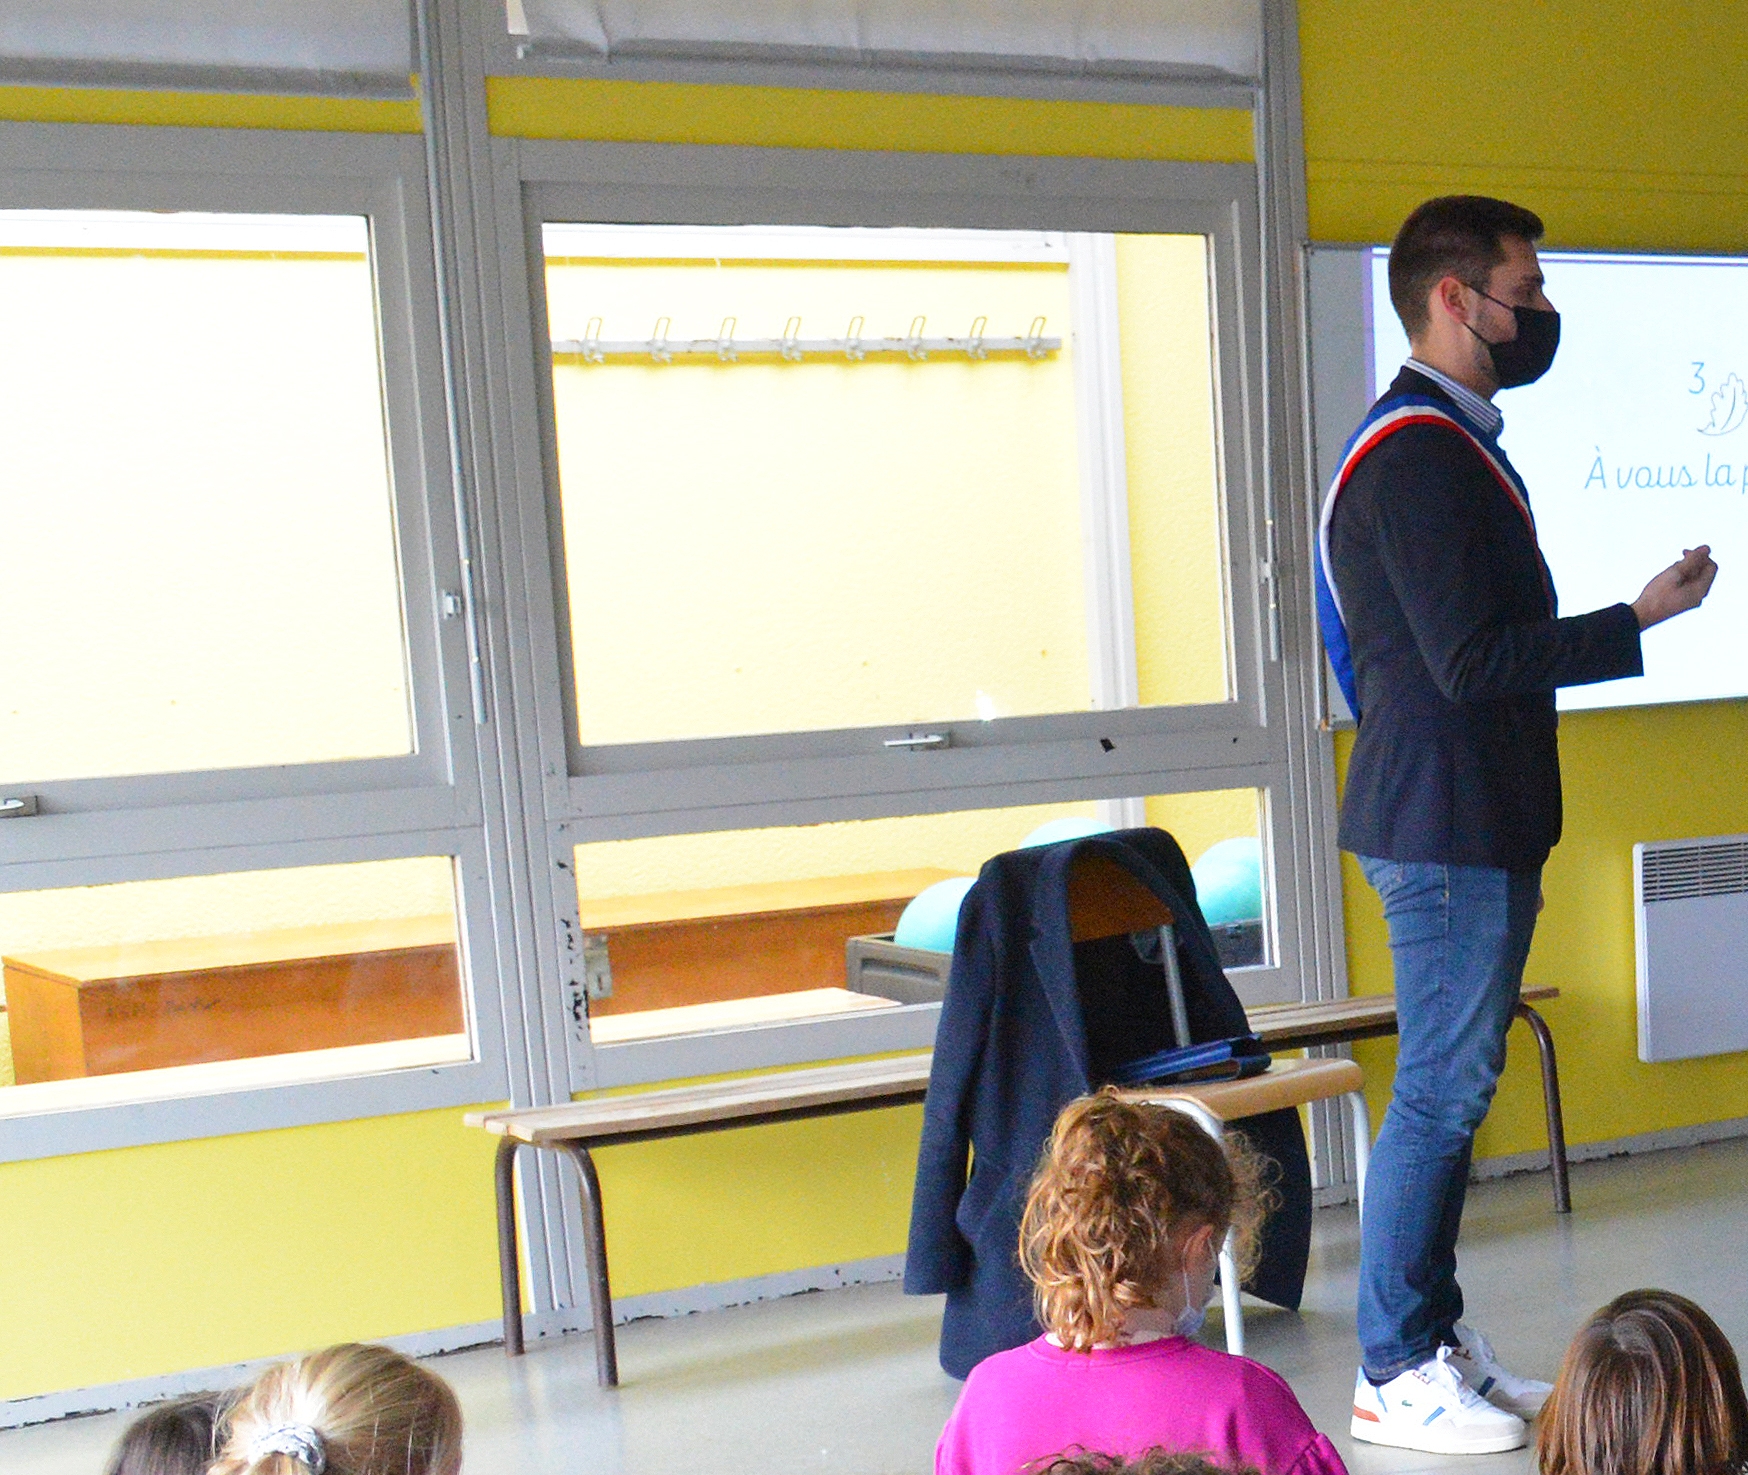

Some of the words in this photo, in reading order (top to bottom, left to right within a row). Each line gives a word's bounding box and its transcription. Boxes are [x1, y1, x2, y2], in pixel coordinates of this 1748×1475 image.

[1688, 361, 1706, 395] 3
[1584, 445, 1607, 490] À
[1616, 464, 1699, 490] vous
[1704, 452, 1738, 488] la
